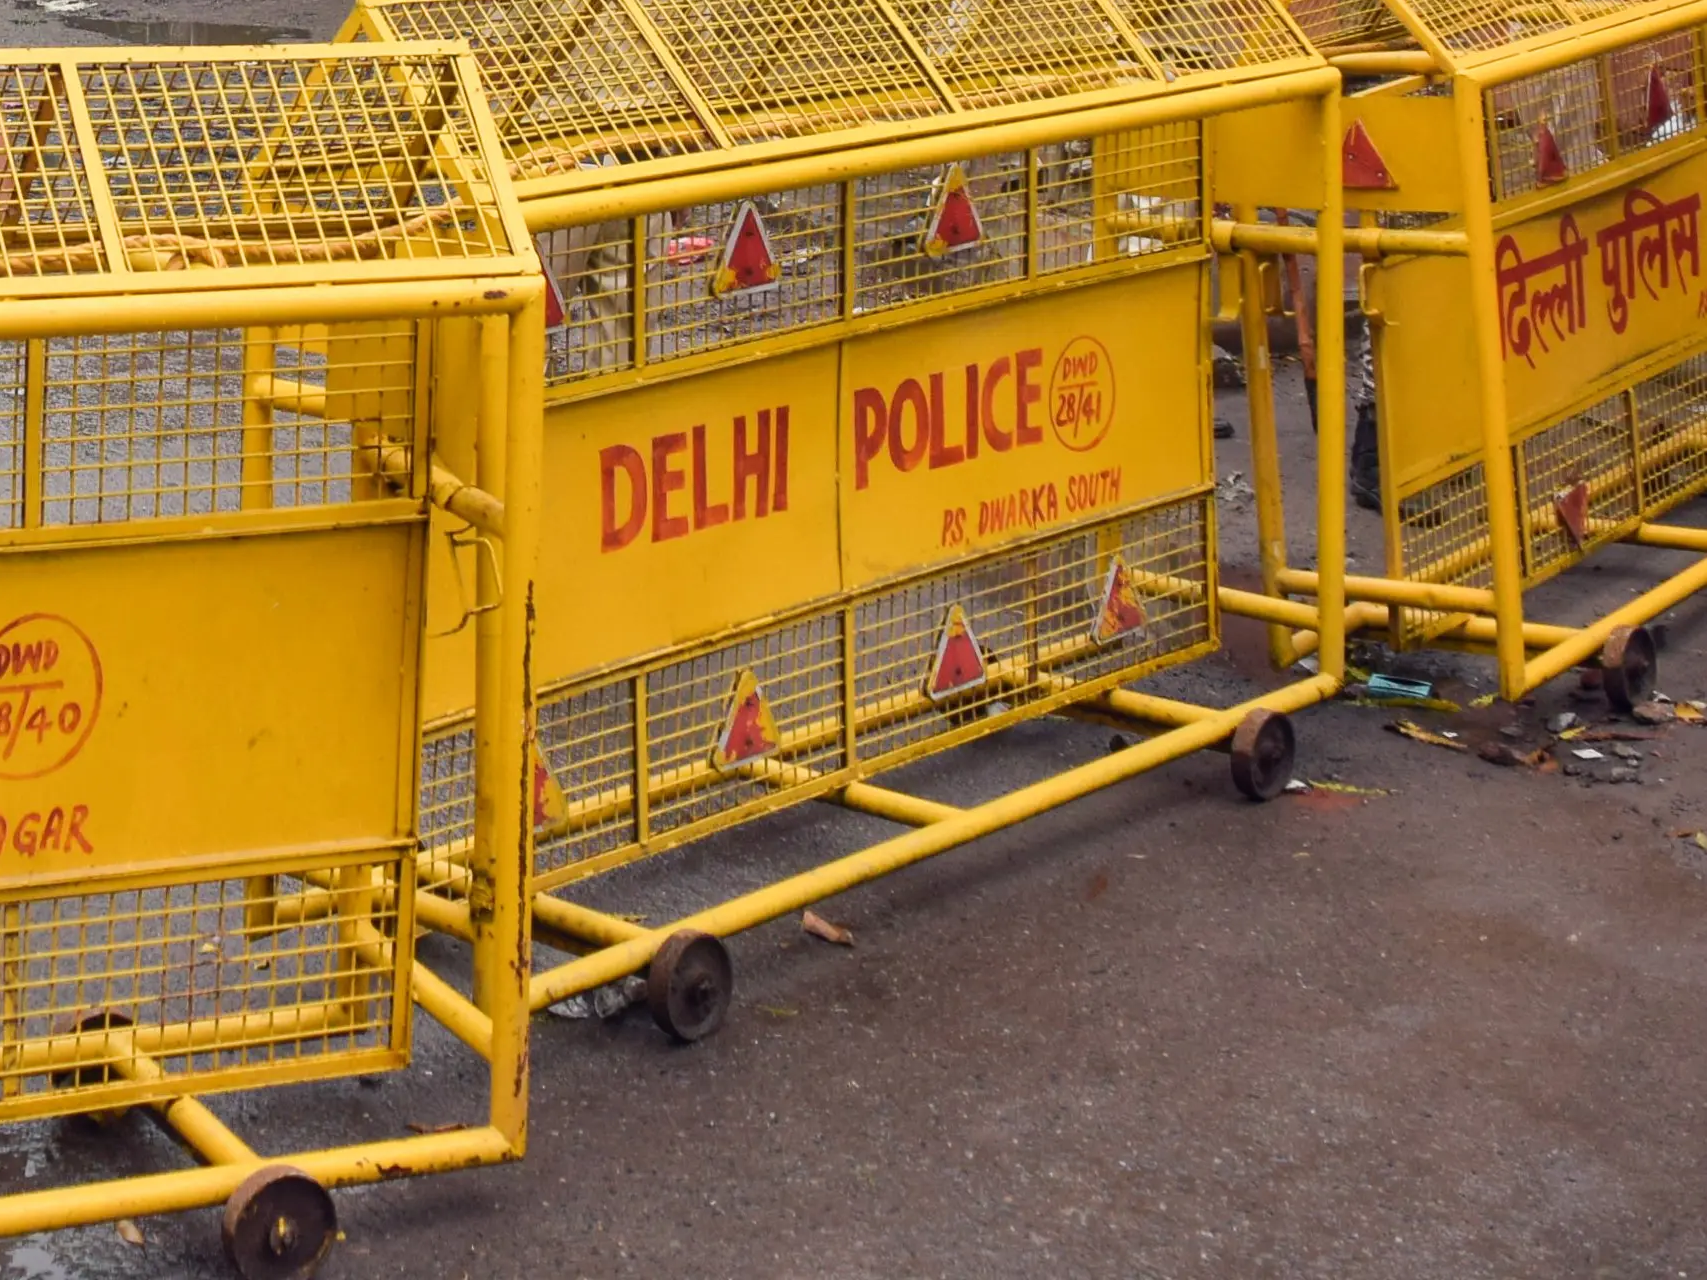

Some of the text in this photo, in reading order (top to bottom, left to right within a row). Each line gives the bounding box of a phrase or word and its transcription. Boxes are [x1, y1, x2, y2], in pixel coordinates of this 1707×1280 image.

[1496, 188, 1702, 371] दिल्ली पुलिस
[1063, 351, 1099, 382] DWD
[1056, 385, 1102, 440] 28/41
[598, 348, 1044, 555] DELHI POLICE
[978, 482, 1058, 529] DWARKA
[1065, 466, 1122, 513] SOUTH
